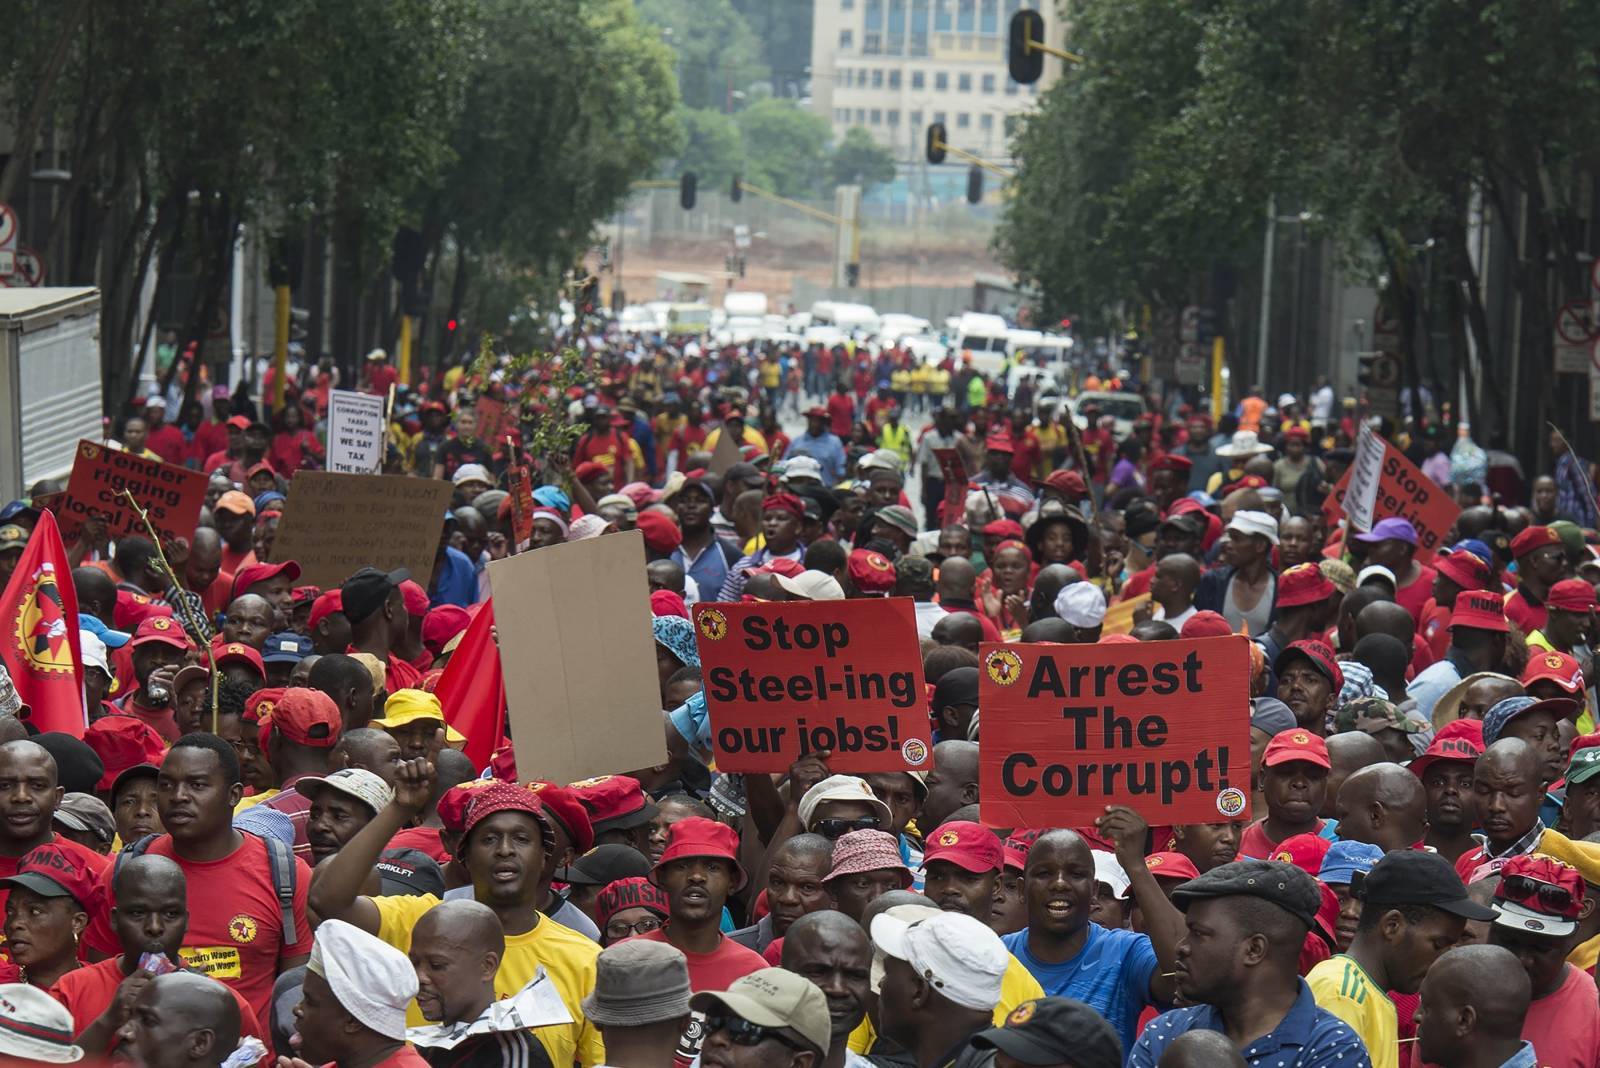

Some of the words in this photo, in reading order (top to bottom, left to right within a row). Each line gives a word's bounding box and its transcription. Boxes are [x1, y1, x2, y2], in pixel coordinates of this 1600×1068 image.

[336, 406, 379, 418] CORRUPTION
[340, 438, 354, 446] WE
[357, 440, 373, 448] SAY
[356, 429, 373, 437] POOR
[103, 448, 187, 484] Tender
[335, 463, 352, 473] THE
[348, 452, 365, 460] TAX
[94, 466, 181, 507] rigging
[1383, 457, 1429, 505] Stop
[742, 615, 850, 657] Stop
[709, 665, 917, 708] Steel-ing
[1027, 650, 1203, 698] Arrest
[718, 725, 786, 753] our
[797, 715, 901, 756] jobs!
[1063, 706, 1169, 750] The
[1002, 746, 1230, 805] Corrupt!
[600, 883, 667, 917] NUMSA
[211, 950, 236, 960] Wages
[216, 961, 236, 970] Wage
